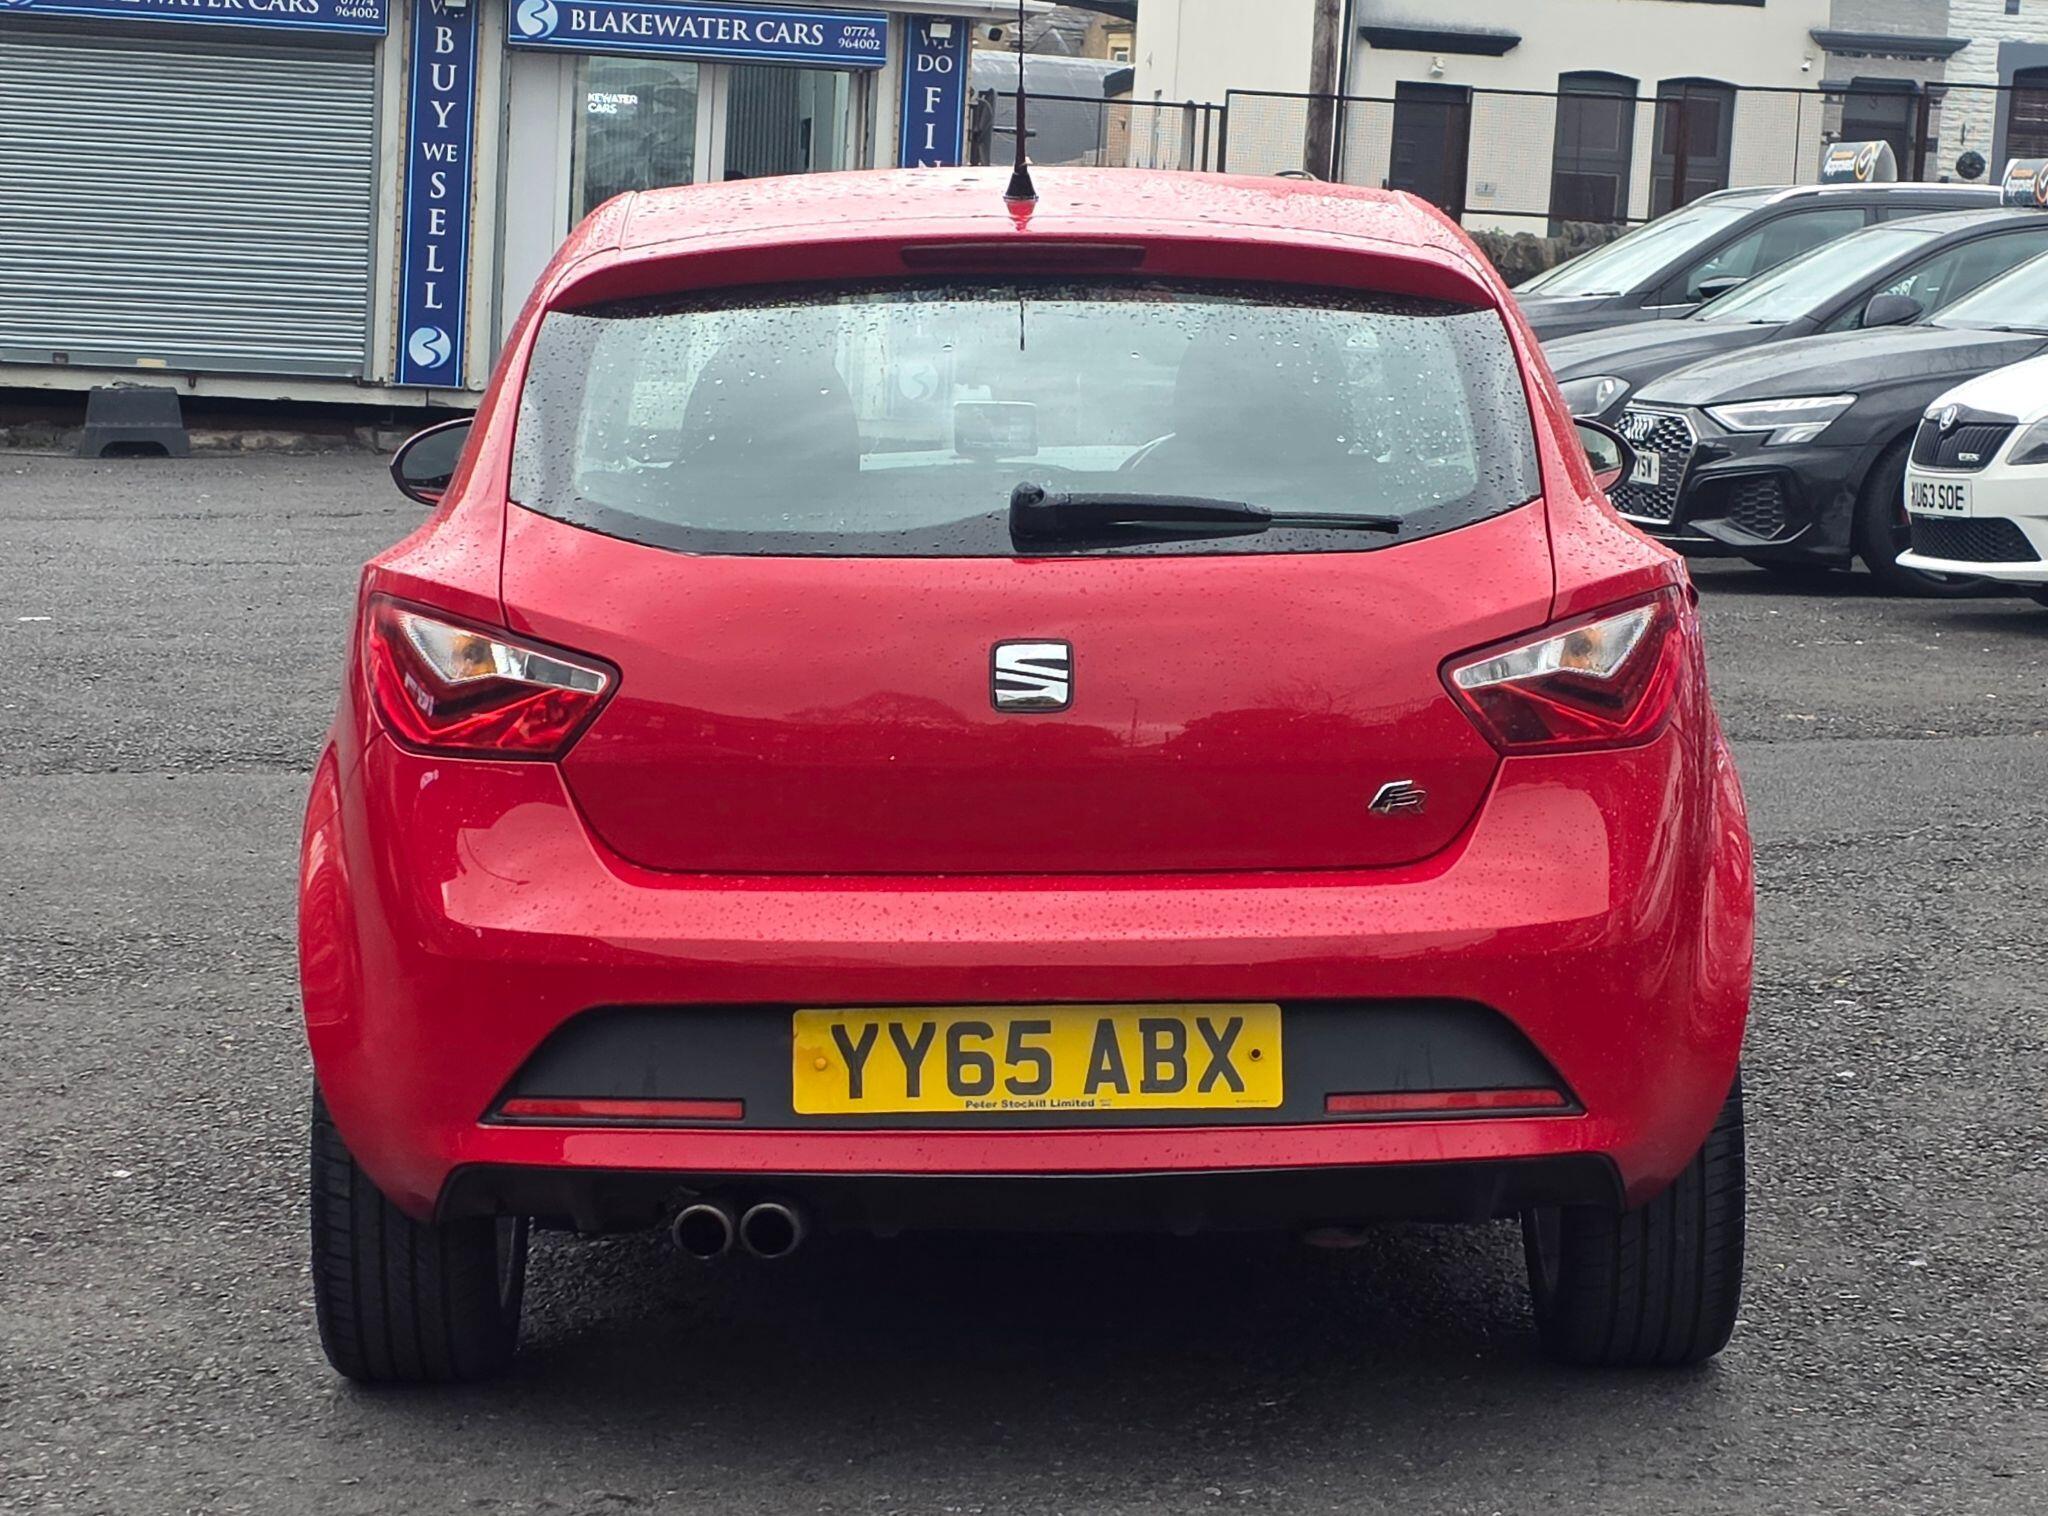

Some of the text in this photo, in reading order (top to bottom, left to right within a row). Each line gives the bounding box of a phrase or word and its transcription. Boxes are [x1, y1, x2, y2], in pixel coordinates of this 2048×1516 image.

[335, 6, 380, 19] 964002
[570, 9, 824, 46] BLAKEWATER CARS
[843, 26, 876, 38] 07774
[838, 38, 881, 51] 964002
[917, 54, 953, 74] DO
[587, 103, 618, 114] CARS
[422, 142, 458, 163] WE
[1938, 484, 1965, 511] SOE
[831, 1017, 1245, 1099] YY65 ABX
[965, 1099, 997, 1109] Peter
[1001, 1099, 1046, 1109] Stockill
[1050, 1098, 1095, 1108] Limited
